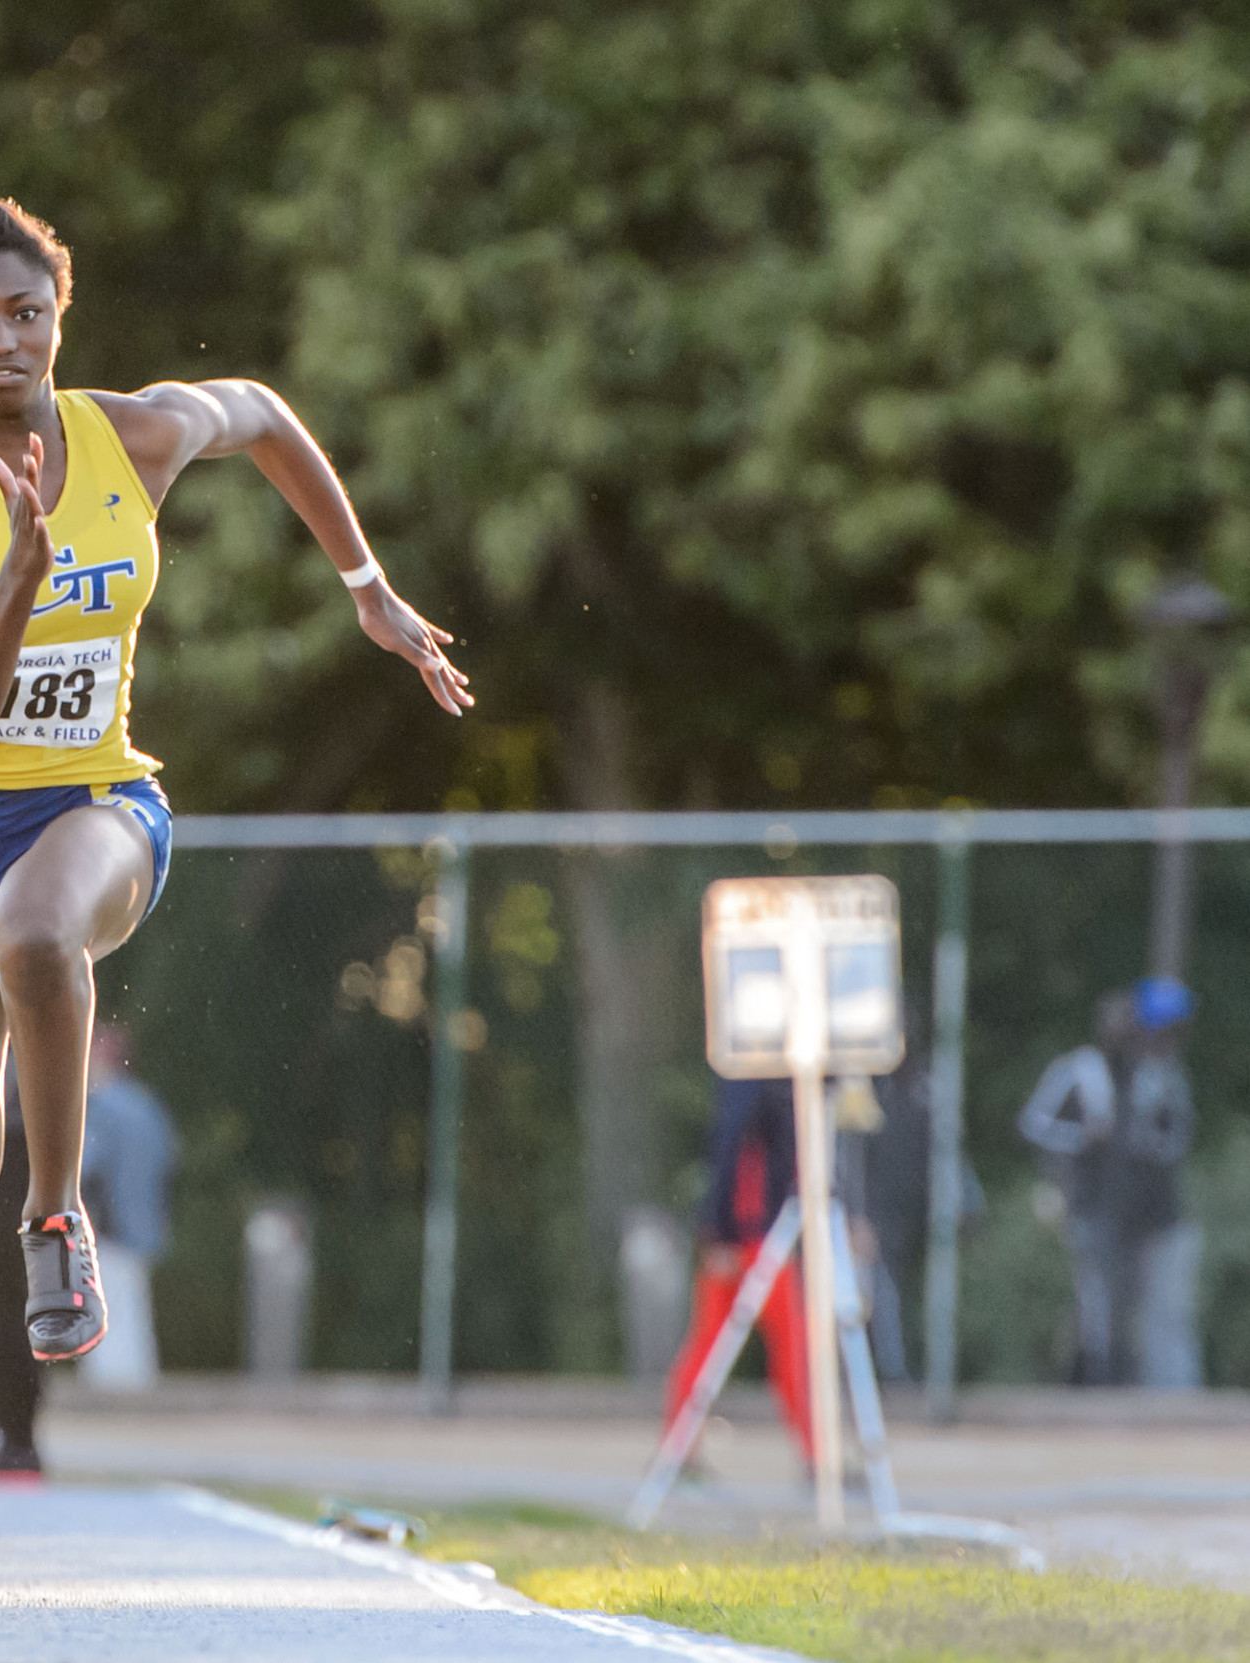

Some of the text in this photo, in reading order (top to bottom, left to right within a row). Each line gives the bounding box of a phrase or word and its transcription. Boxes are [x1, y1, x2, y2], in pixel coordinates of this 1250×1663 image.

[16, 648, 112, 668] ORGIA TECH
[34, 726, 46, 738] &
[54, 728, 101, 740] FIELD
